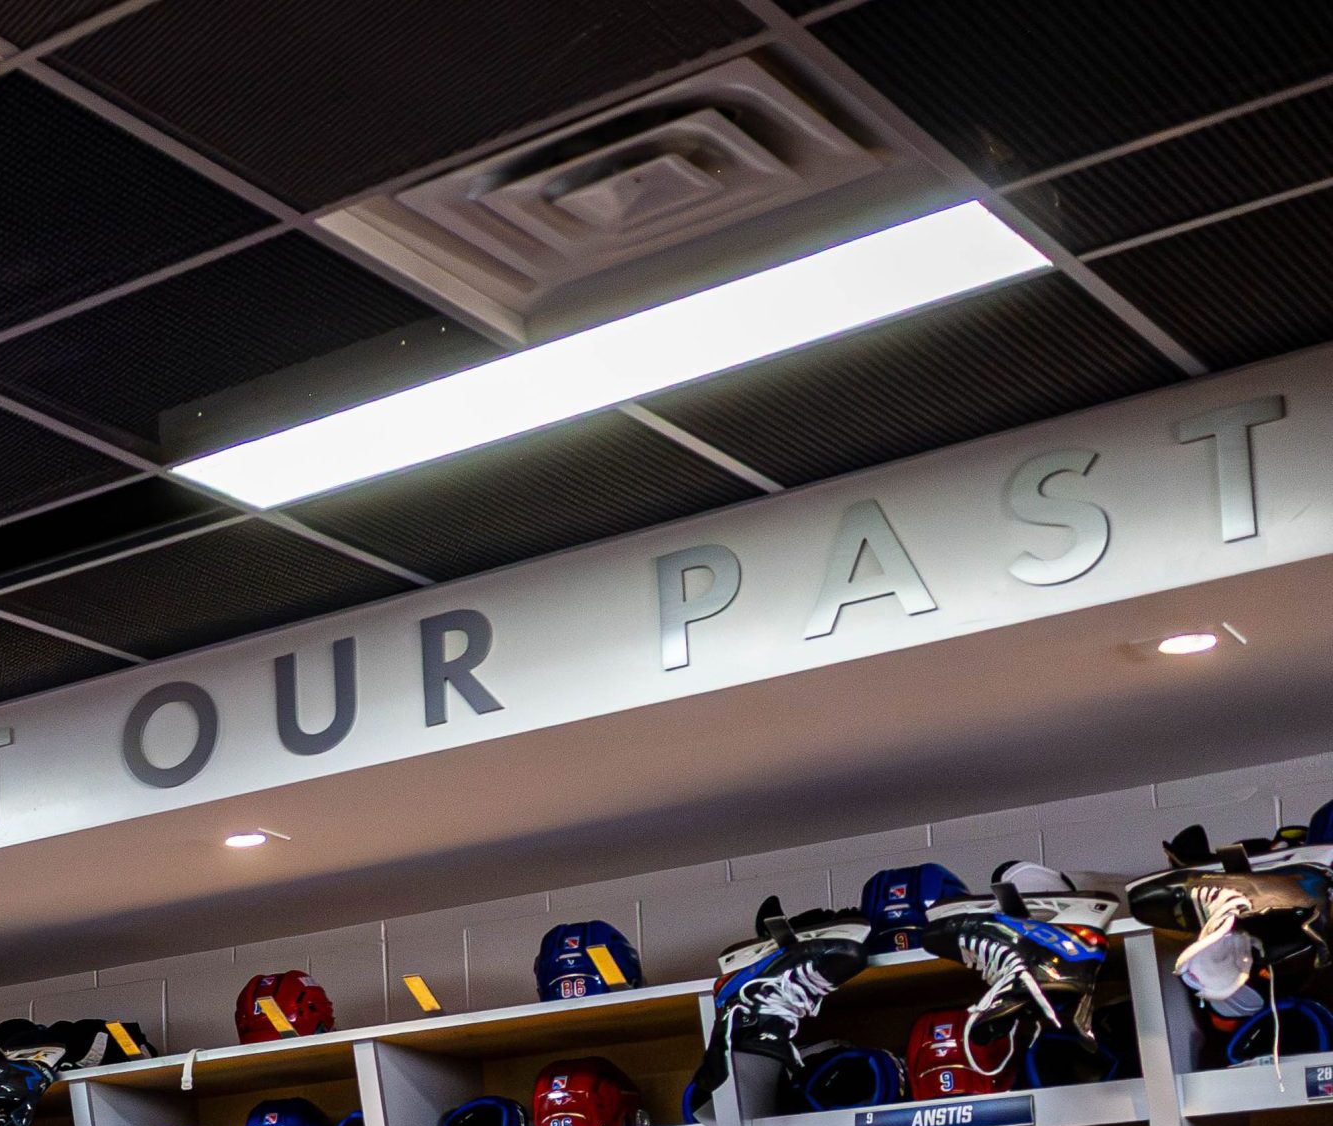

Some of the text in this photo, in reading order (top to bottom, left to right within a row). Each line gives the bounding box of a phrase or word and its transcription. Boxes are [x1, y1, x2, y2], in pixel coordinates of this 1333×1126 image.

[123, 609, 505, 788] OUR
[654, 395, 1286, 672] PAST
[894, 931, 908, 951] 9
[561, 979, 586, 998] 86
[940, 1071, 953, 1092] 9
[866, 1112, 874, 1124] 9
